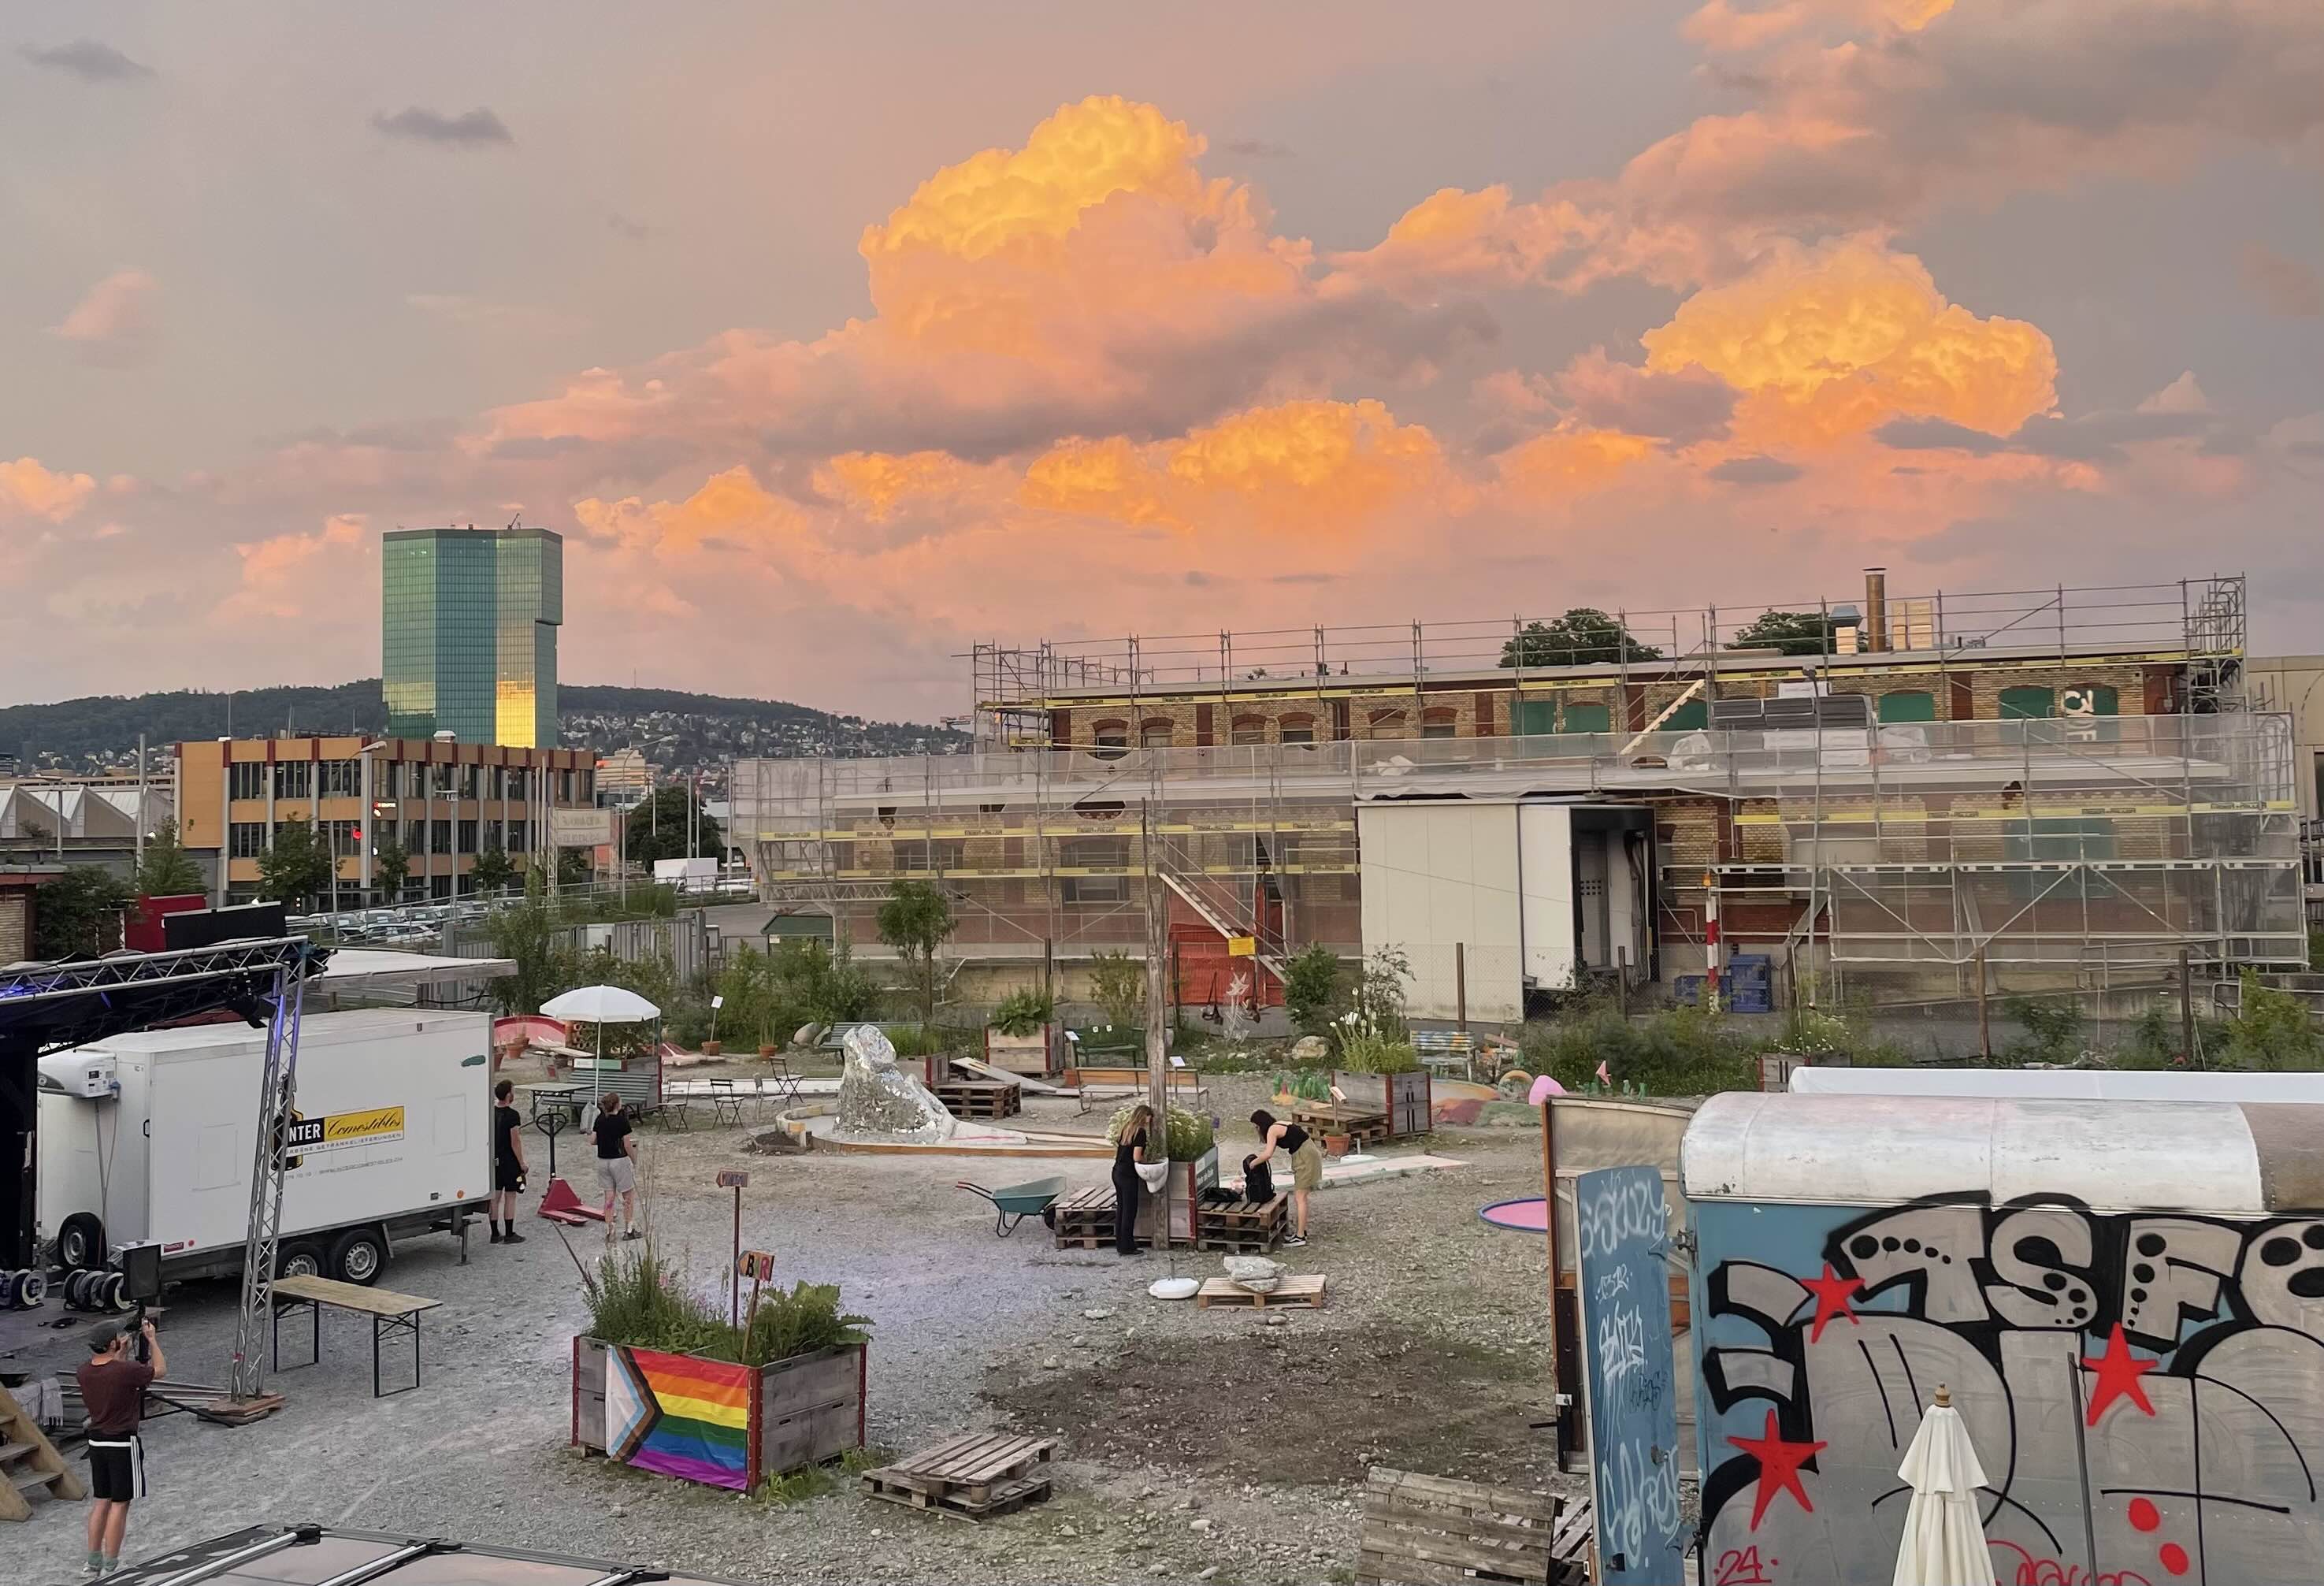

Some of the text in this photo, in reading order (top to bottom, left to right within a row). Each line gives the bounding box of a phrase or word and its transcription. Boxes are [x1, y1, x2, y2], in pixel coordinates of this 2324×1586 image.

[288, 1109, 401, 1142] NTER Comestibles
[745, 1254, 770, 1281] BR
